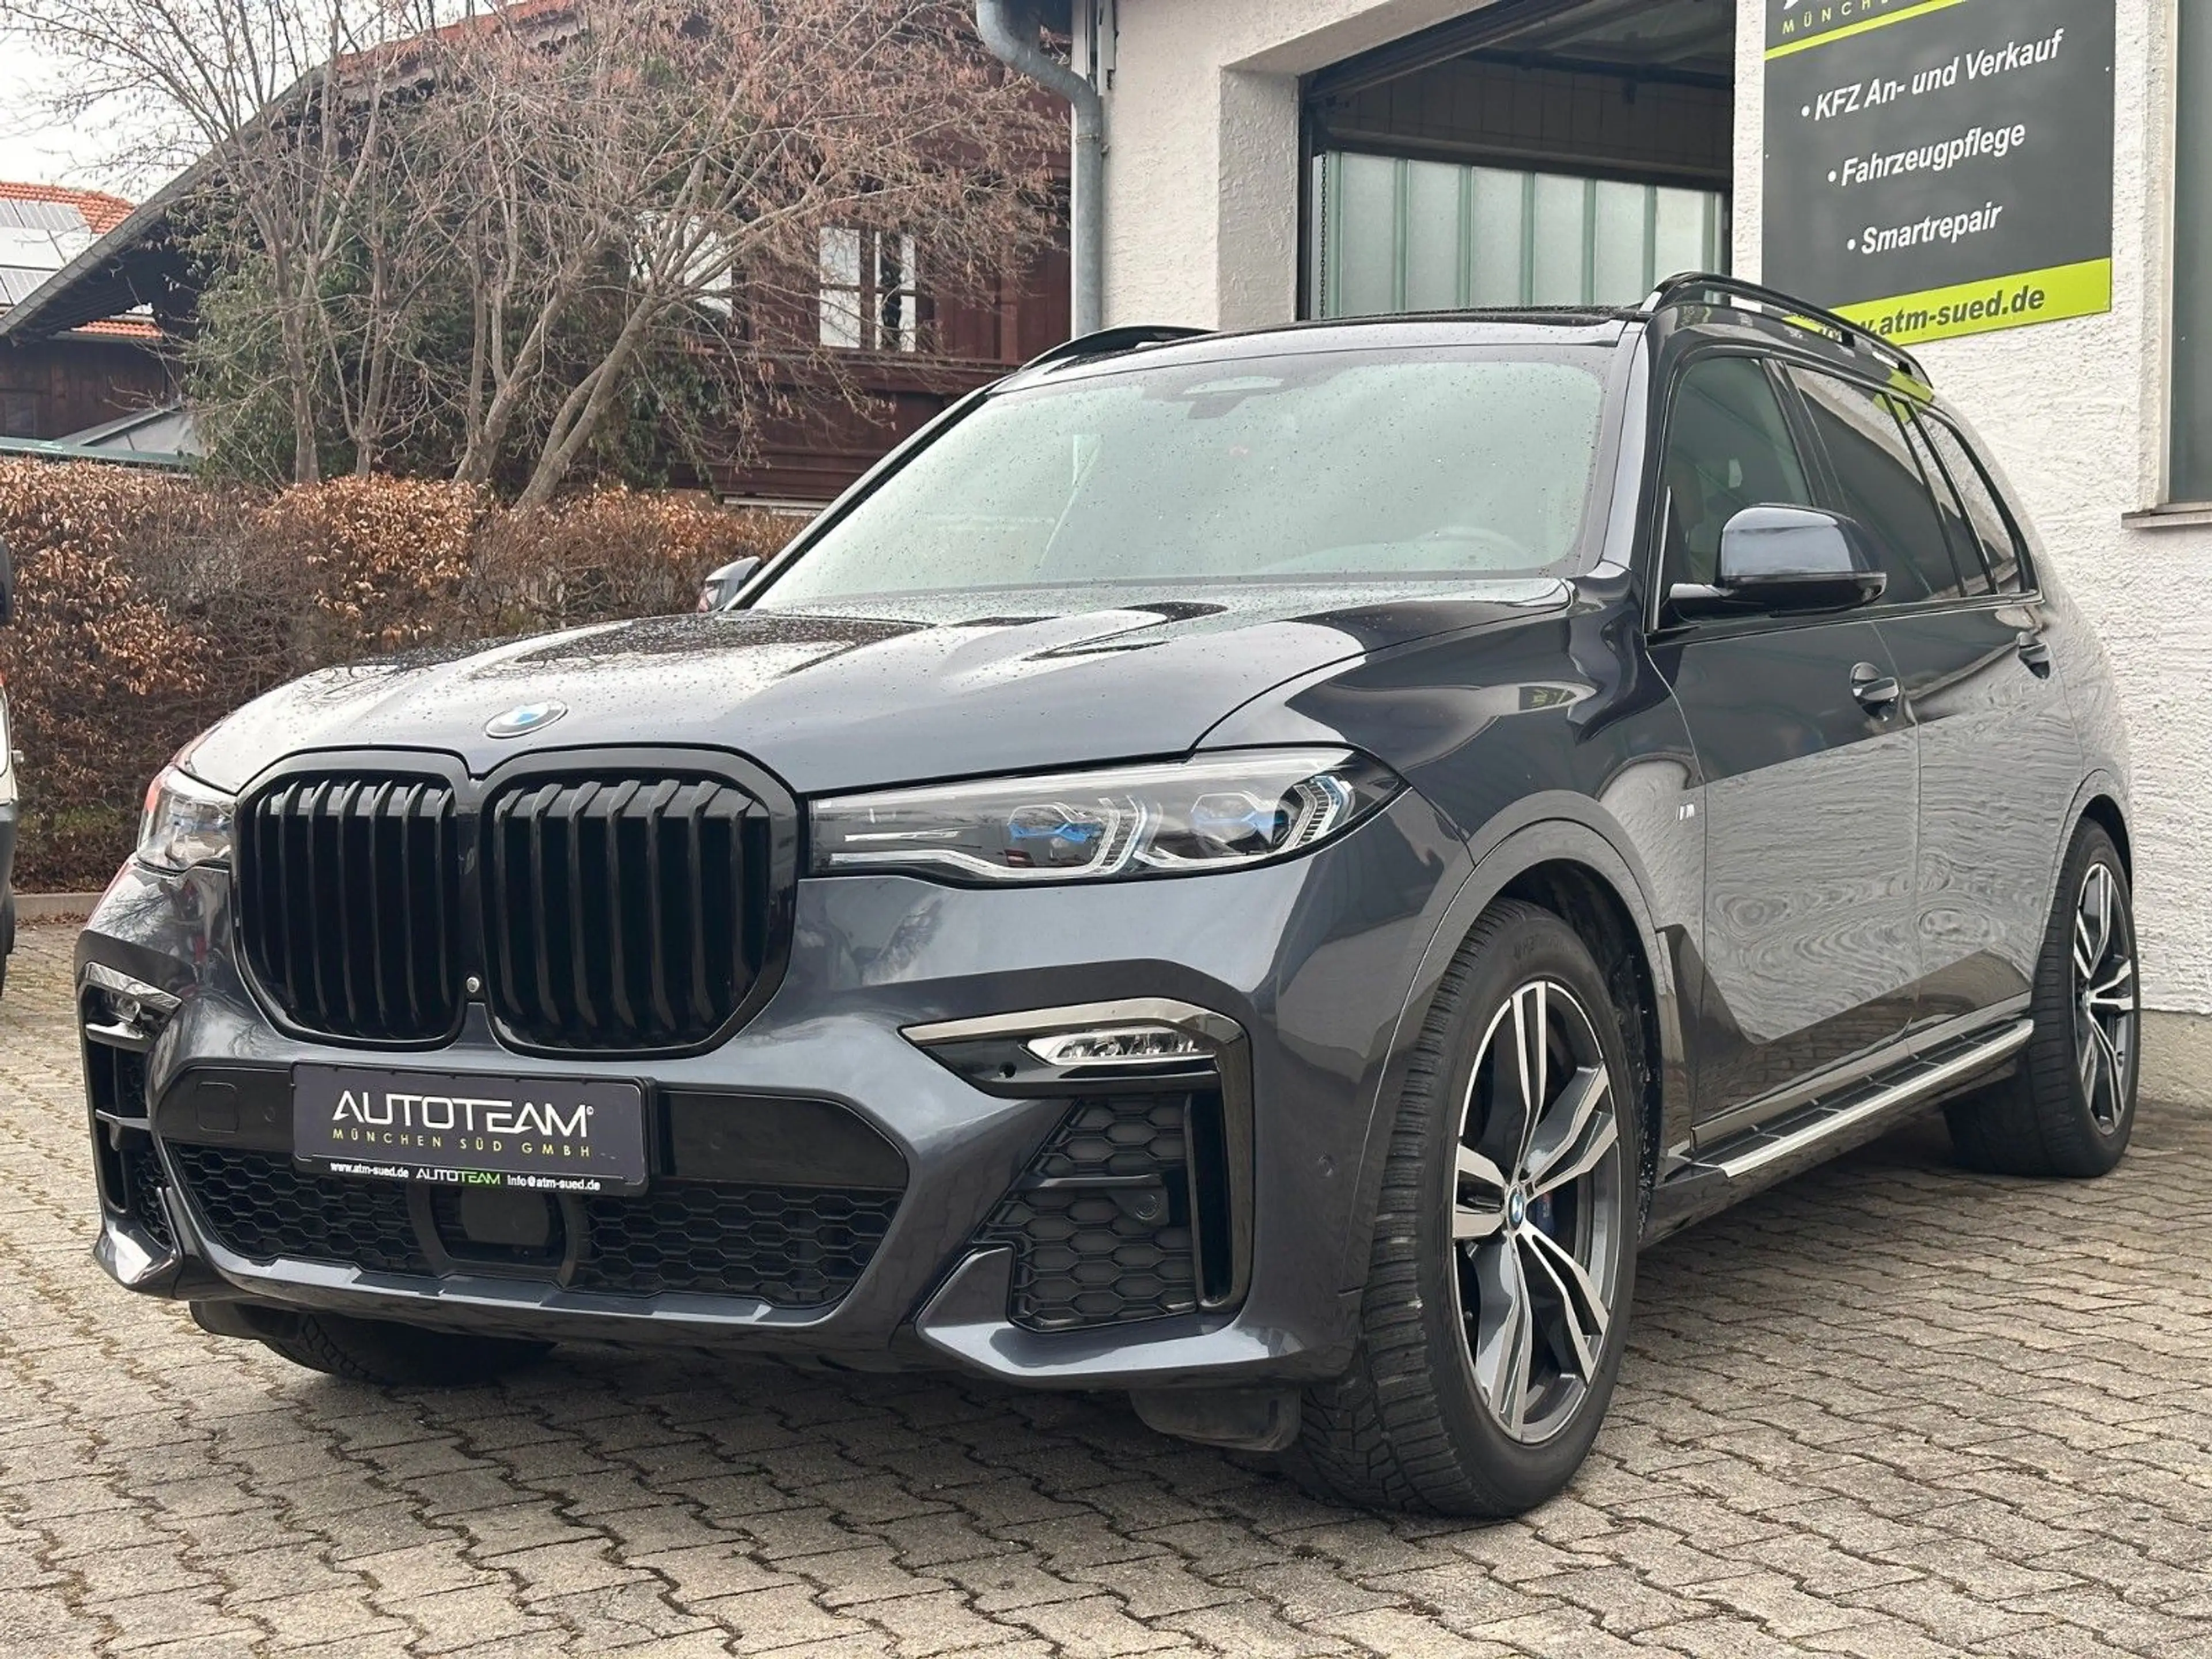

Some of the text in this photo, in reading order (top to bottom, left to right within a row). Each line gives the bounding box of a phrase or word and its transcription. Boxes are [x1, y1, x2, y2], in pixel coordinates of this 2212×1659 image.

[1782, 0, 1889, 34] MÜNCH
[1815, 28, 2065, 121] KFZ An- und Verkauf
[1841, 123, 2026, 187] Fahrzeugpflege
[1861, 201, 2003, 254] Smartrepair
[332, 1127, 591, 1158] MÜNCHEN SÜD GMBH
[330, 1161, 601, 1191] www.atm-sued.de AUTOTEAM info@atm-sued.de
